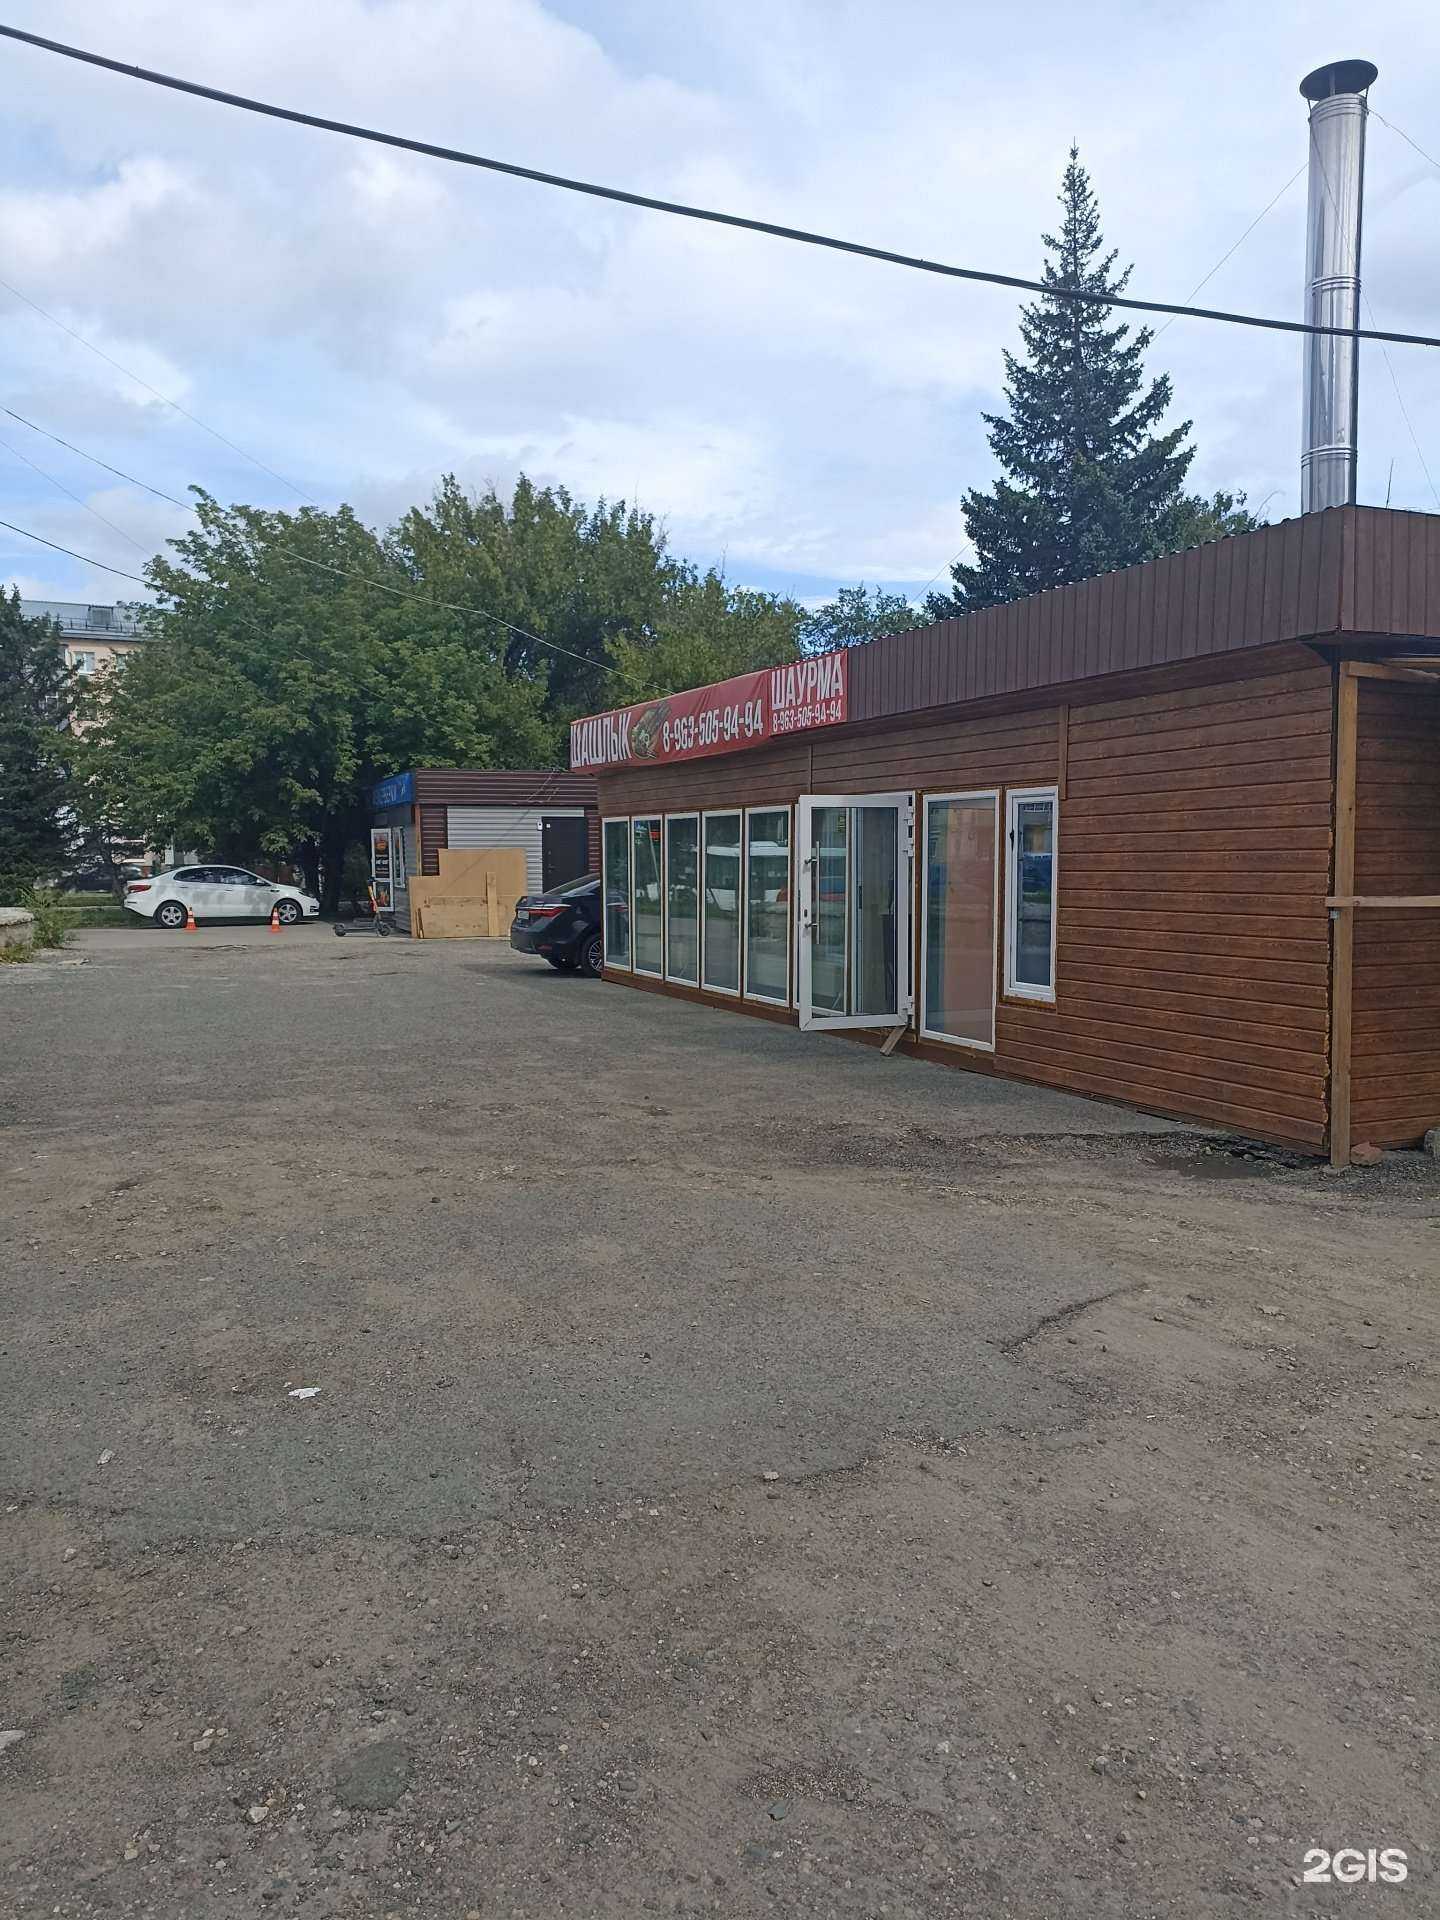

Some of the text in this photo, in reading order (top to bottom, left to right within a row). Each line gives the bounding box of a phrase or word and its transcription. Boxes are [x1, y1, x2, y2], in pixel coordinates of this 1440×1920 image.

[771, 653, 844, 710] ШАУРМА
[570, 698, 763, 768] ШАШЛЫК 8-963-505-94-94
[772, 699, 842, 732] 8-963-505-94-94
